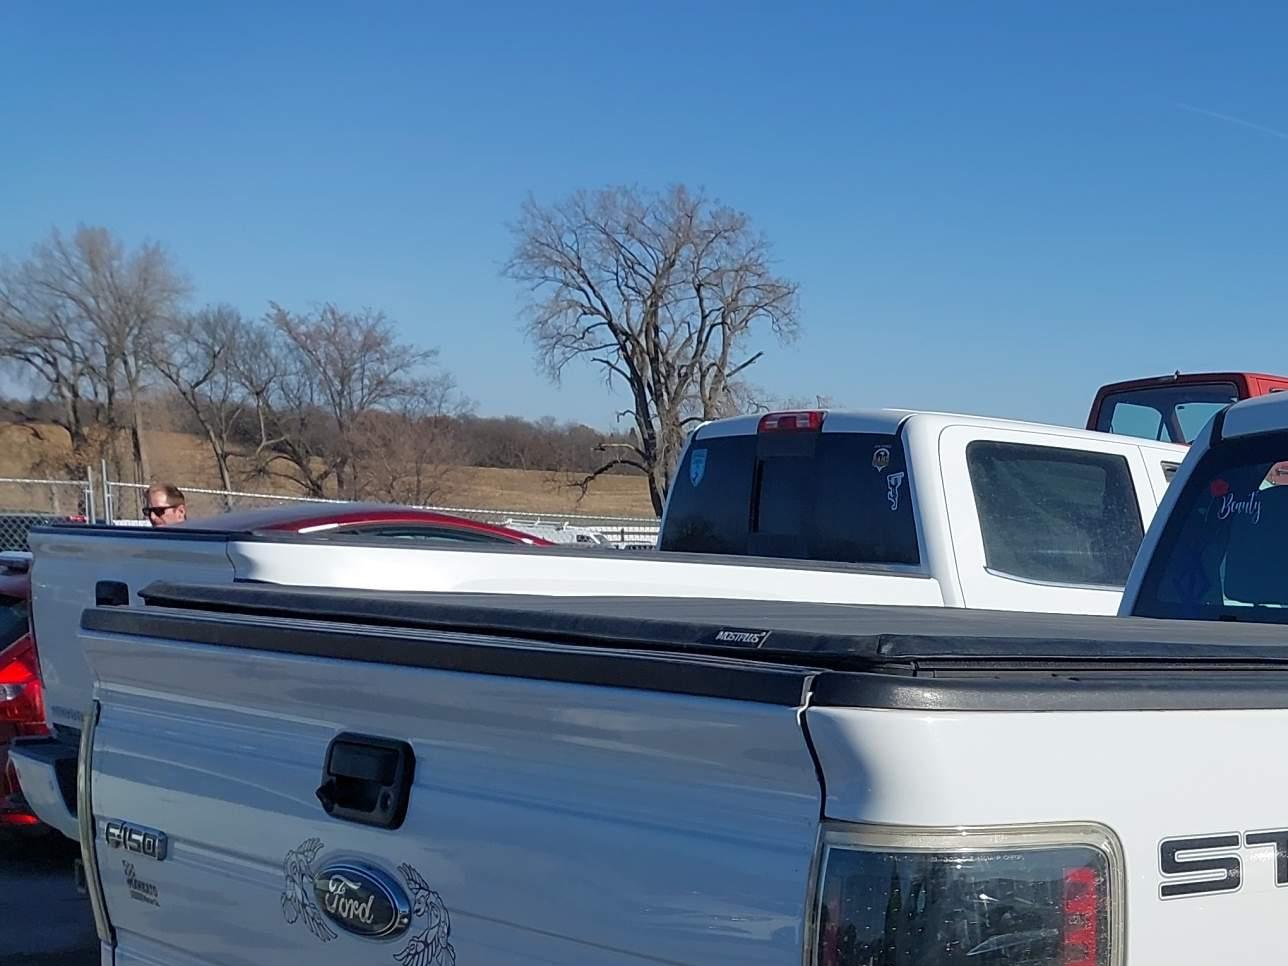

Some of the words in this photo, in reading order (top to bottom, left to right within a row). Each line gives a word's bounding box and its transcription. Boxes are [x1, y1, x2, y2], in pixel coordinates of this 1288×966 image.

[1217, 492, 1261, 524] Beauty
[105, 822, 159, 858] F150
[325, 874, 375, 924] Ford
